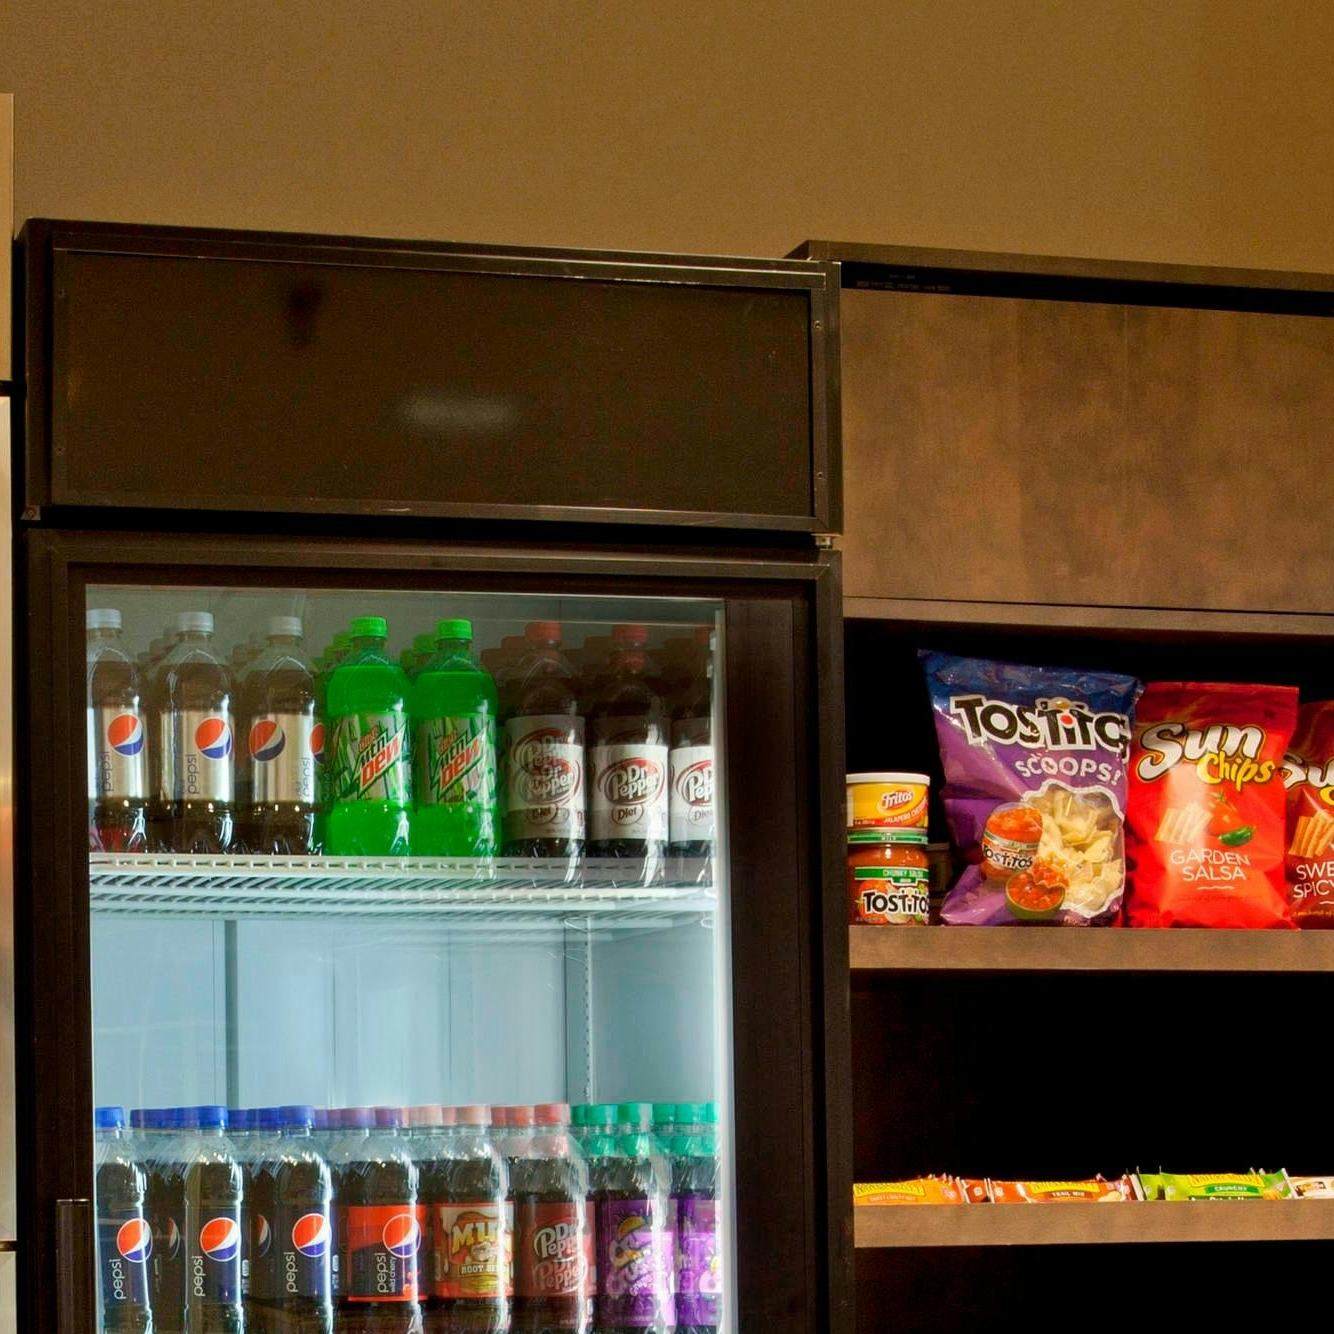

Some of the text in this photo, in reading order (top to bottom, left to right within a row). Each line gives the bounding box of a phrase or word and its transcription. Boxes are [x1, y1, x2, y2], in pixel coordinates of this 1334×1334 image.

[102, 750, 114, 792] pepsi
[1015, 757, 1121, 786] SCOOPS!
[1137, 722, 1265, 783] Sun
[187, 754, 200, 795] pepsi
[610, 772, 660, 801] Pepper
[628, 765, 647, 782] Dr
[1196, 753, 1276, 792] Chips
[617, 806, 637, 820] Diet
[884, 790, 913, 809] Fritos
[1170, 848, 1251, 866] GARDEN
[1183, 865, 1246, 881] SALSA
[109, 1257, 125, 1300] pepsi
[191, 1255, 206, 1297] pepsi
[283, 1251, 298, 1293] pepsi
[374, 1252, 390, 1293] pepsi
